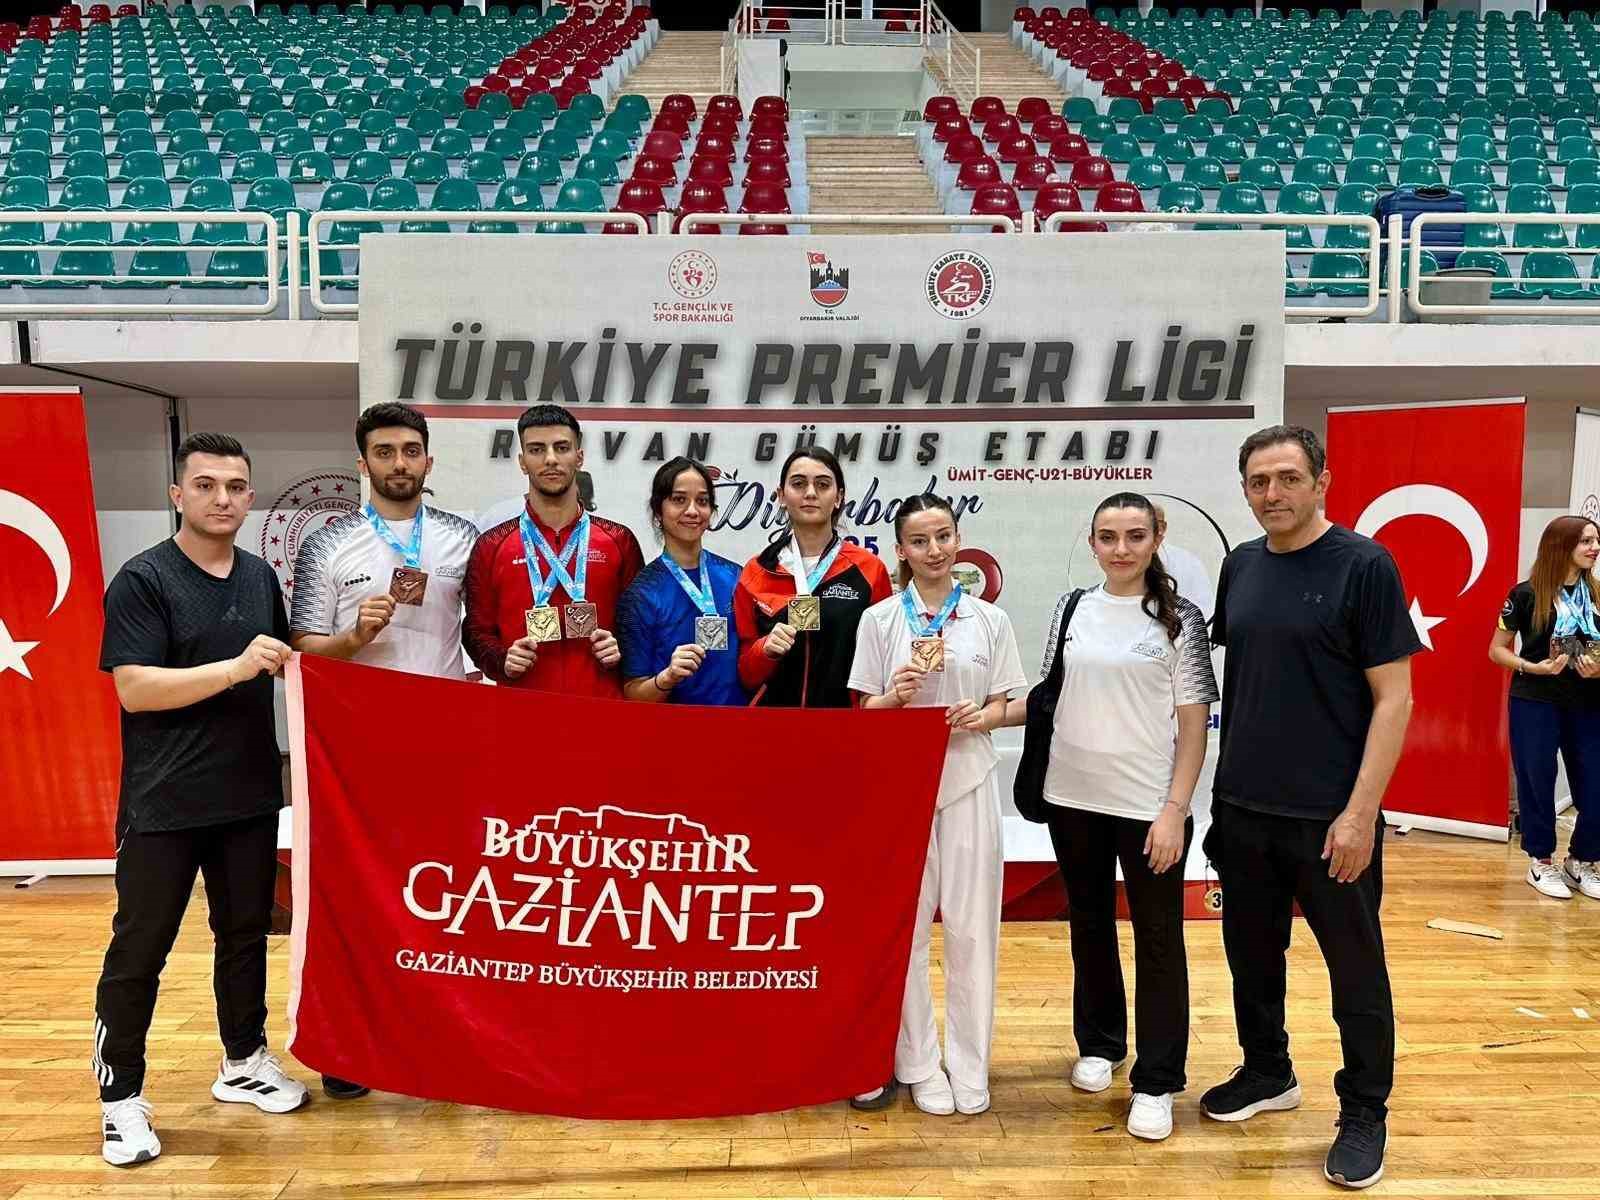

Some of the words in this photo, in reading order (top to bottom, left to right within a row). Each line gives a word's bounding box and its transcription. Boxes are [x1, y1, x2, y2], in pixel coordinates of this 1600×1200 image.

[653, 302, 671, 311] T.C.
[673, 301, 717, 313] GENÇLİK
[719, 302, 733, 311] VE
[653, 313, 679, 322] SPOR
[681, 313, 734, 322] BAKANLIĞI
[395, 322, 719, 404] TÜRKİYE
[744, 327, 1075, 405] PREMİER
[1103, 324, 1256, 403] LİGİ
[490, 429, 711, 462] RVAN
[755, 425, 940, 466] GÜMÜŞ
[983, 430, 1160, 462] ETABI
[947, 466, 1153, 483] ÜMİT-GENÇ-U21-BÜYÜKLER
[480, 816, 758, 878] BÜYÜKŞEHİR
[402, 860, 825, 951] GAZİANTEP
[1212, 892, 1222, 908] 3
[395, 949, 534, 983] GAZİANTEP
[538, 963, 689, 993] BÜYÜKŞEHİR
[693, 965, 818, 990] BELEDİYESİ
